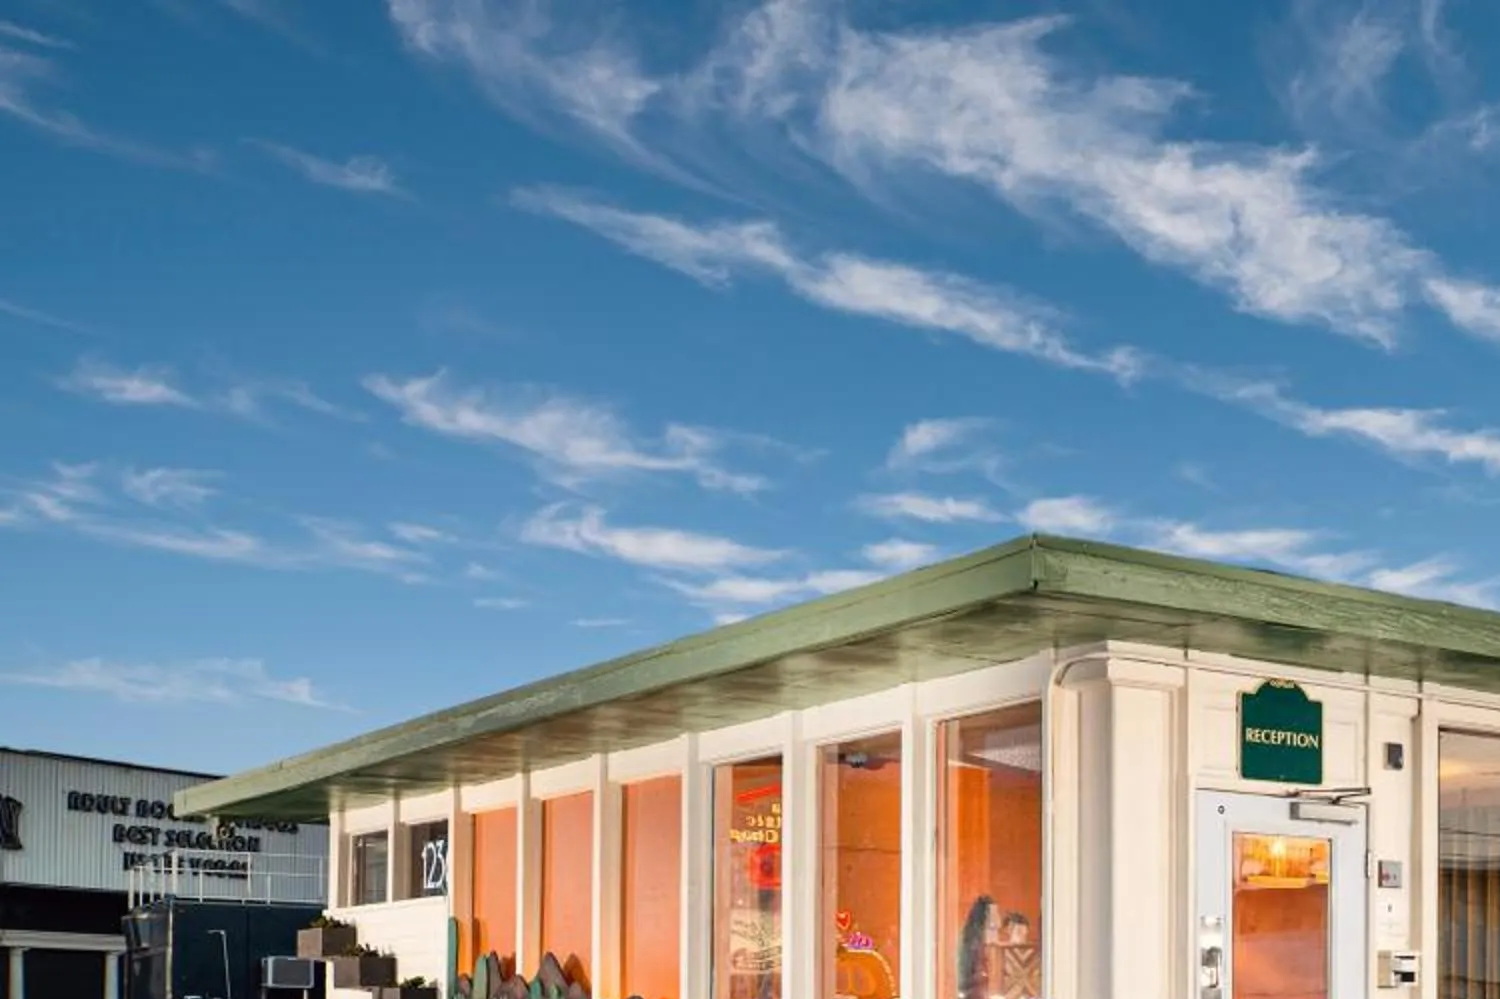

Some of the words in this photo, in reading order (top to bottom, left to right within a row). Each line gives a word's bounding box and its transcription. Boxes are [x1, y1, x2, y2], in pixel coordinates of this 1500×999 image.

[1245, 727, 1319, 750] RECEPTION
[67, 791, 131, 816] ADULT
[112, 823, 161, 846] BEST
[421, 839, 448, 890] 123
